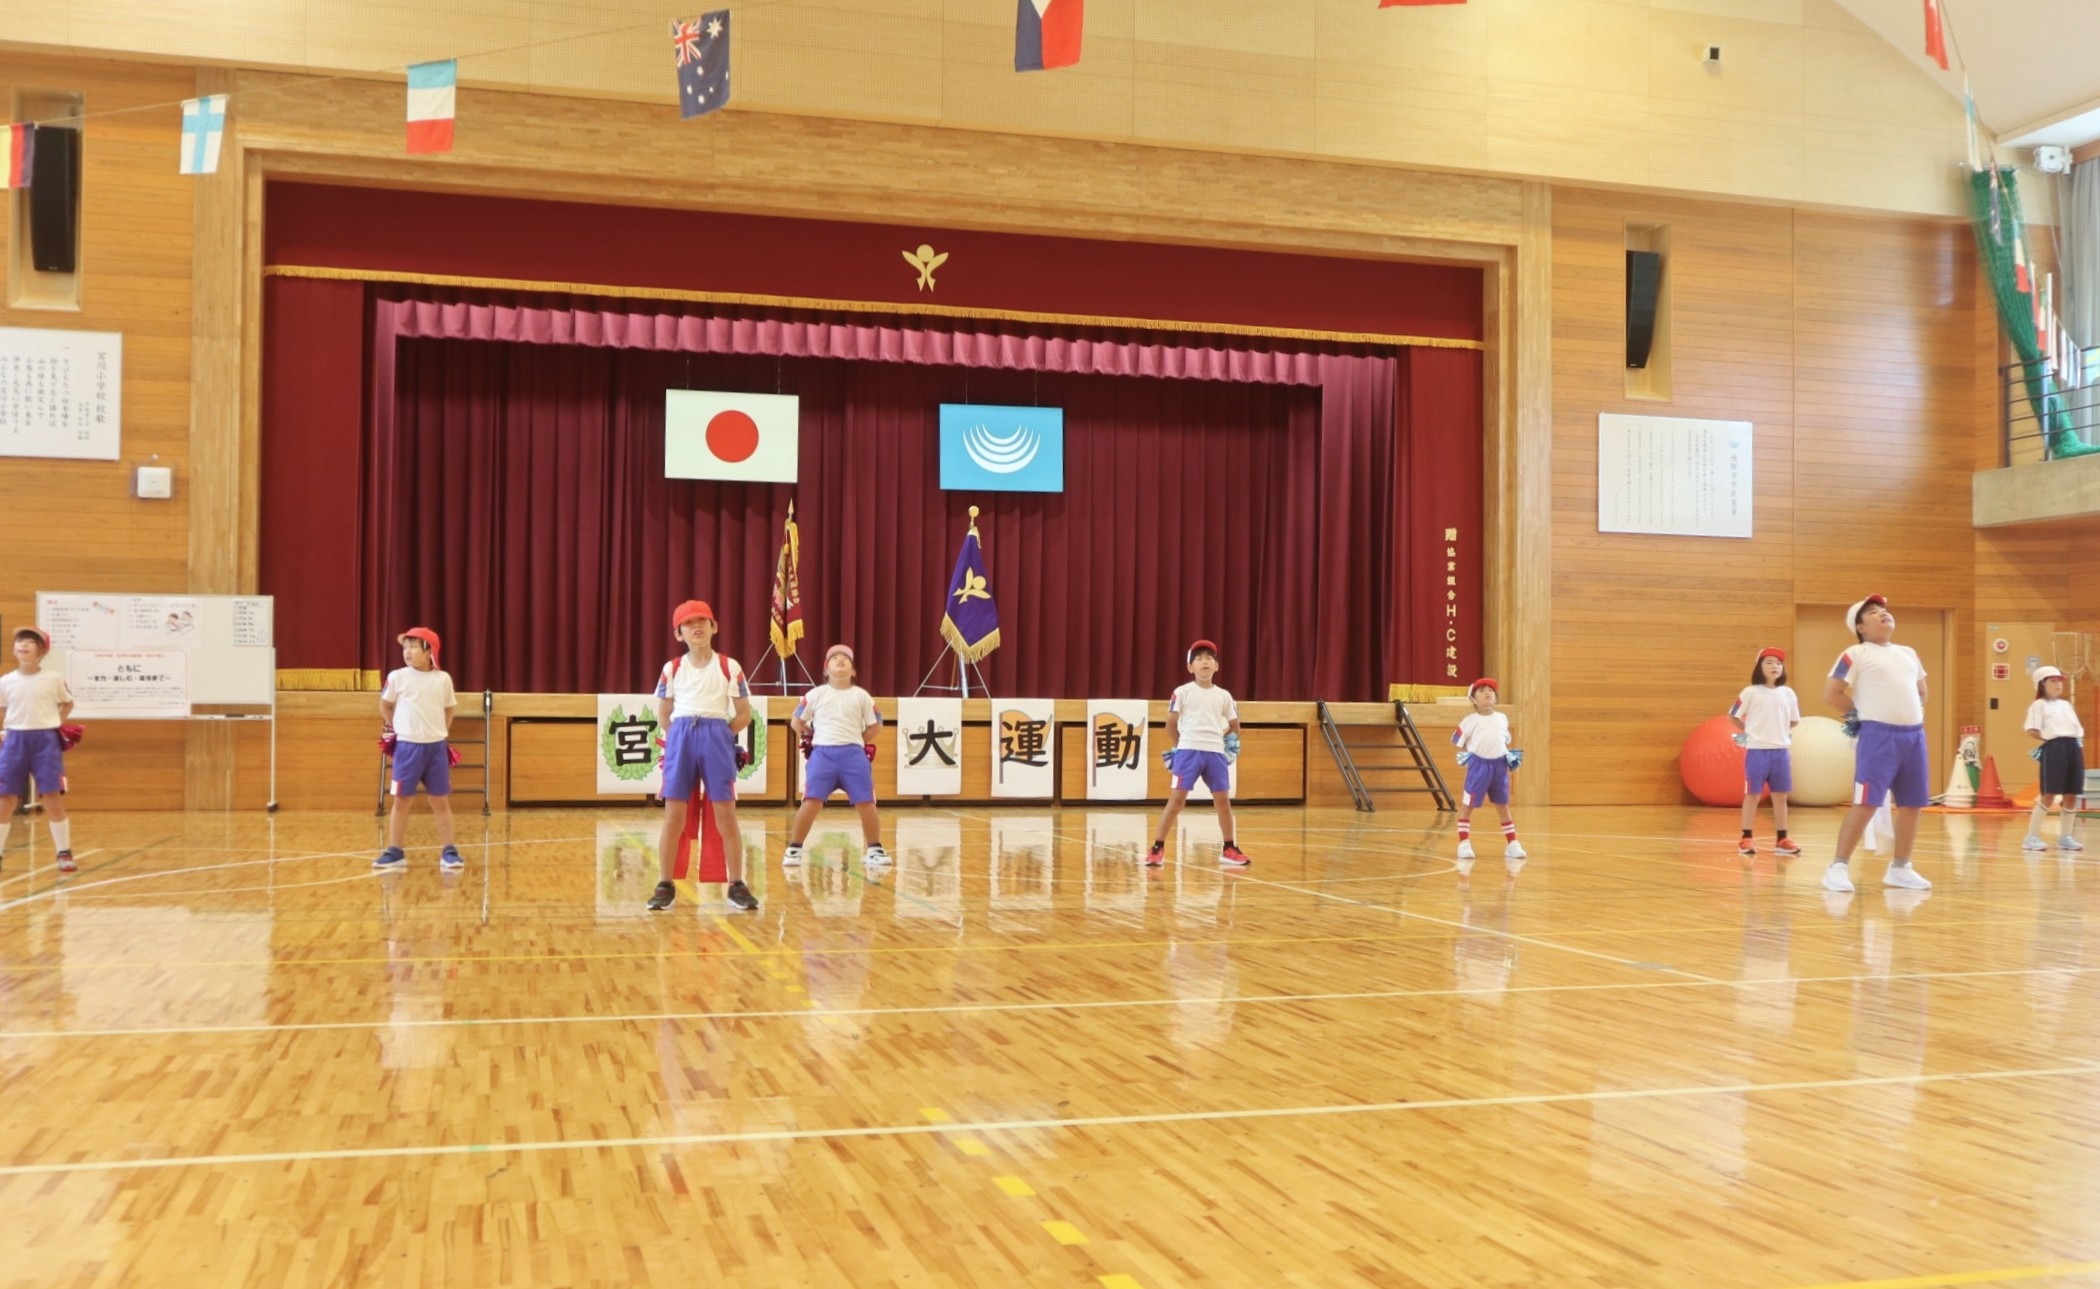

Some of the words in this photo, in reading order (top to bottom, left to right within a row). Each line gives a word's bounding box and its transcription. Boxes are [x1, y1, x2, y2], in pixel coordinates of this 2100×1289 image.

[95, 350, 107, 401] 宮川小学校
[95, 403, 106, 425] 校歌
[1444, 527, 1458, 542] 贈
[117, 664, 142, 673] ともに
[608, 714, 658, 767] 宮
[908, 719, 956, 767] 大
[1000, 719, 1049, 768] 運
[1094, 723, 1141, 769] 動
